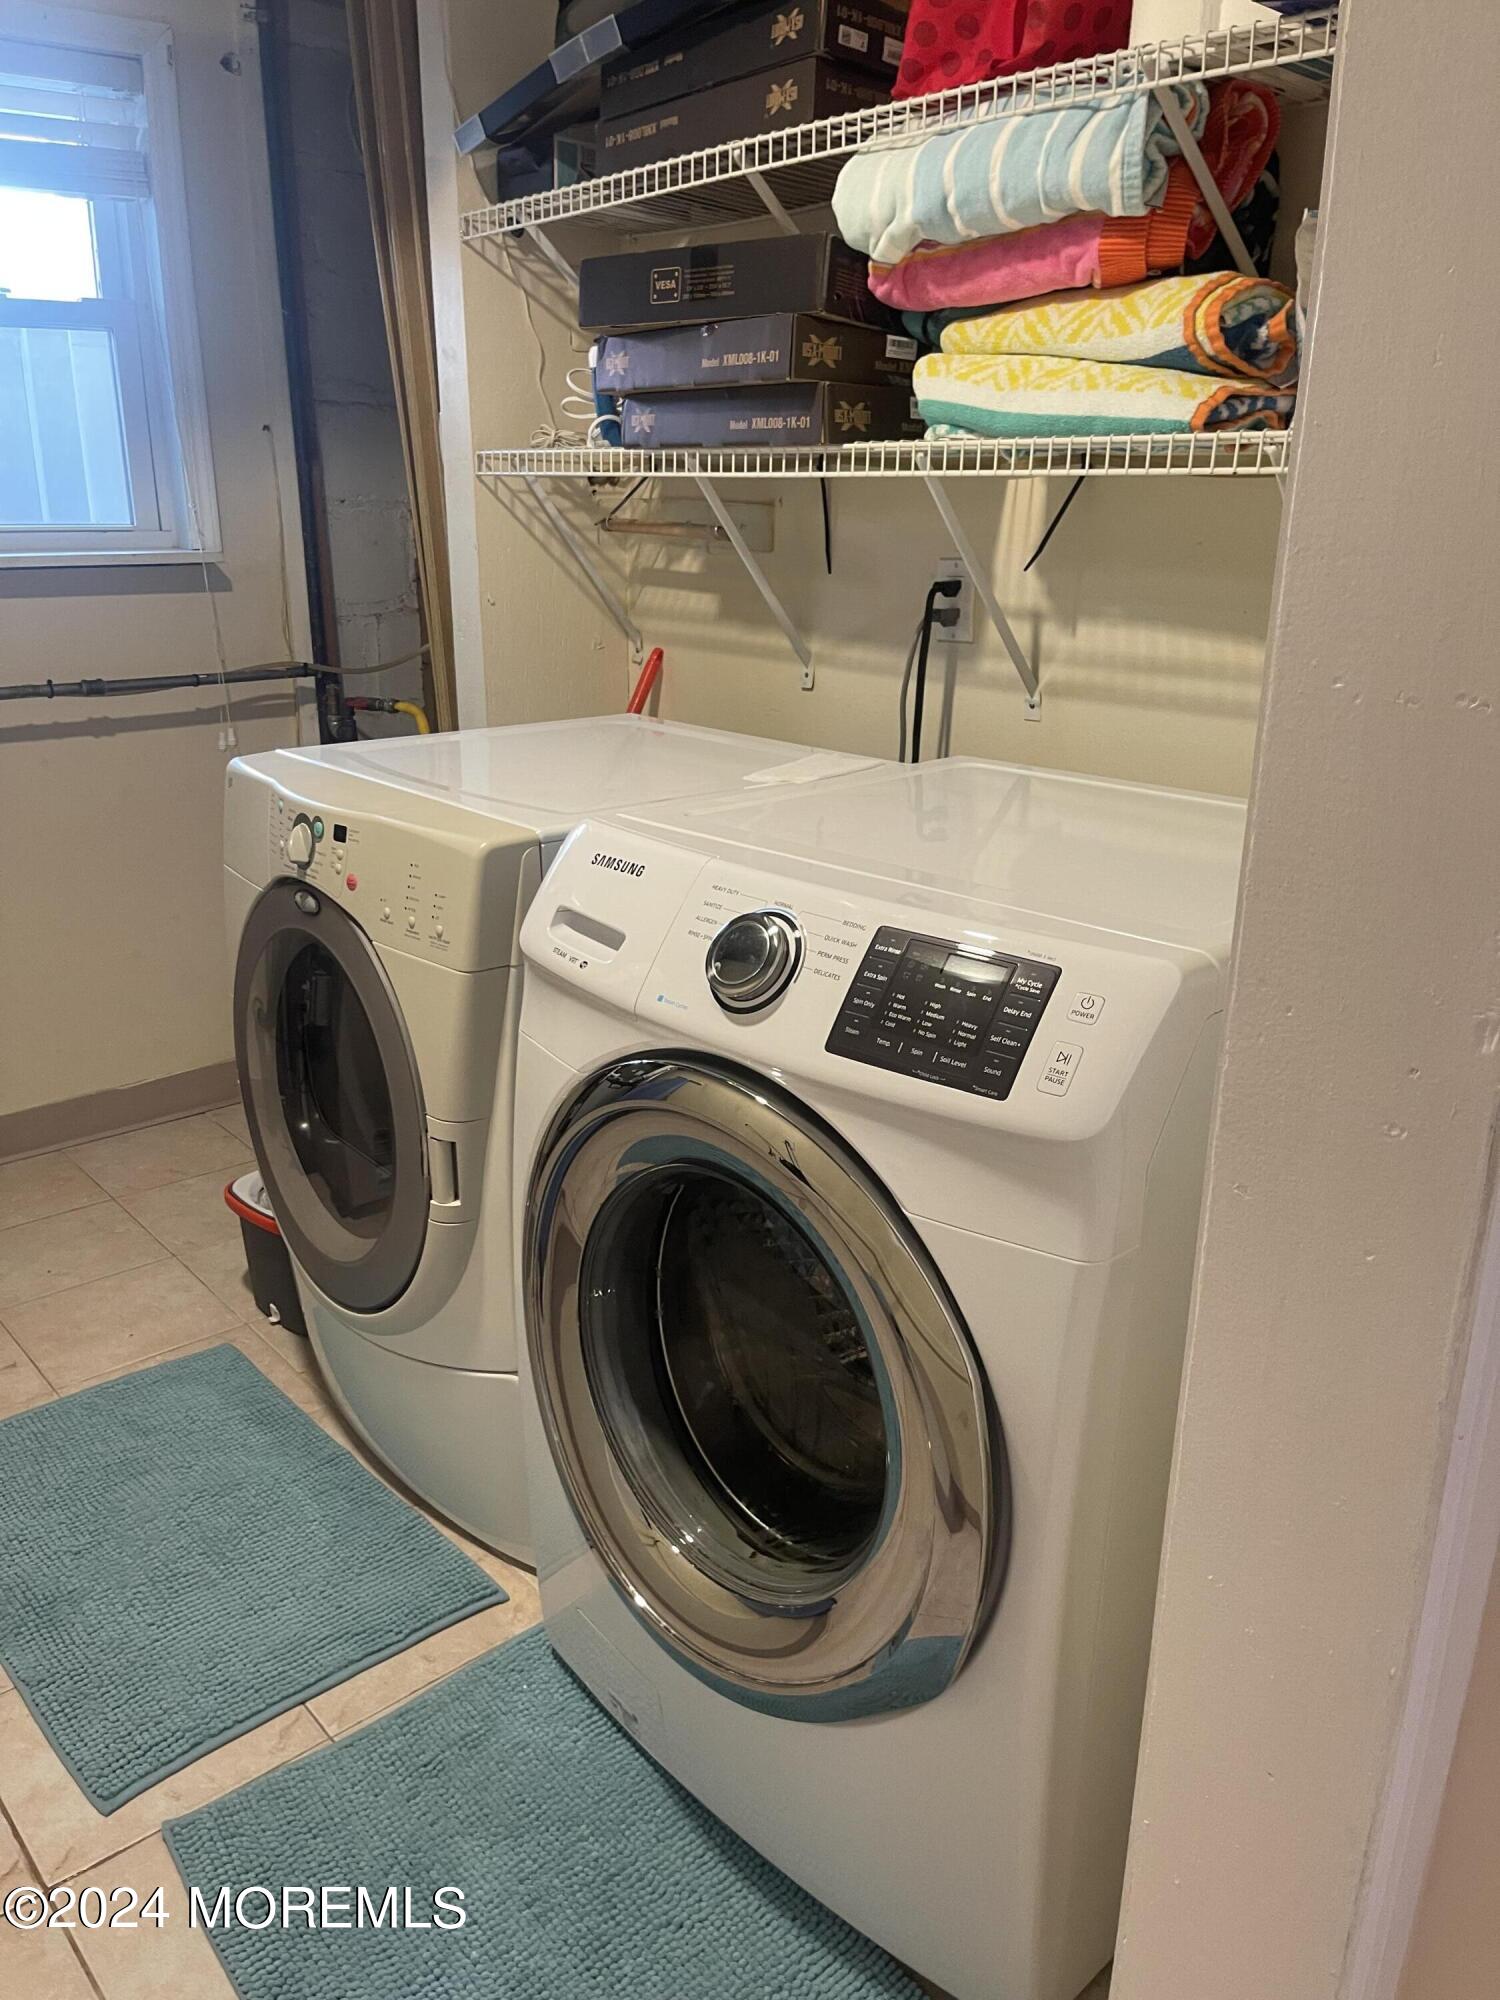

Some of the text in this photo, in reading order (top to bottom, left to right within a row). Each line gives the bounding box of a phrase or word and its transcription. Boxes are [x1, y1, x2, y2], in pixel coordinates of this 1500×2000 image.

[655, 279, 677, 290] VESA
[702, 350, 779, 368] Model XML008-1K-01
[730, 416, 810, 430] Model XML008-1K-01
[592, 853, 645, 877] SAMSUNG
[842, 920, 866, 931] BEDDING
[824, 935, 857, 948] QUICK WASH
[875, 944, 888, 952] Extra
[817, 950, 849, 965] PERM PRESS
[813, 968, 841, 981] DELICATES
[864, 971, 877, 979] Extra
[1017, 977, 1043, 989] My Cycle
[863, 1000, 875, 1009] Only
[925, 1011, 945, 1020] Medium
[1003, 1006, 1032, 1019] Delay End
[1071, 1009, 1095, 1020] POWER
[961, 1021, 978, 1030] Heavy
[957, 1030, 977, 1040] Normal
[989, 1034, 1002, 1042] Self
[953, 1039, 967, 1048] Light
[939, 1055, 968, 1069] Soil Level
[983, 1066, 1002, 1076] Sound
[1048, 1067, 1069, 1077] START
[1044, 1075, 1065, 1086] PAUSE
